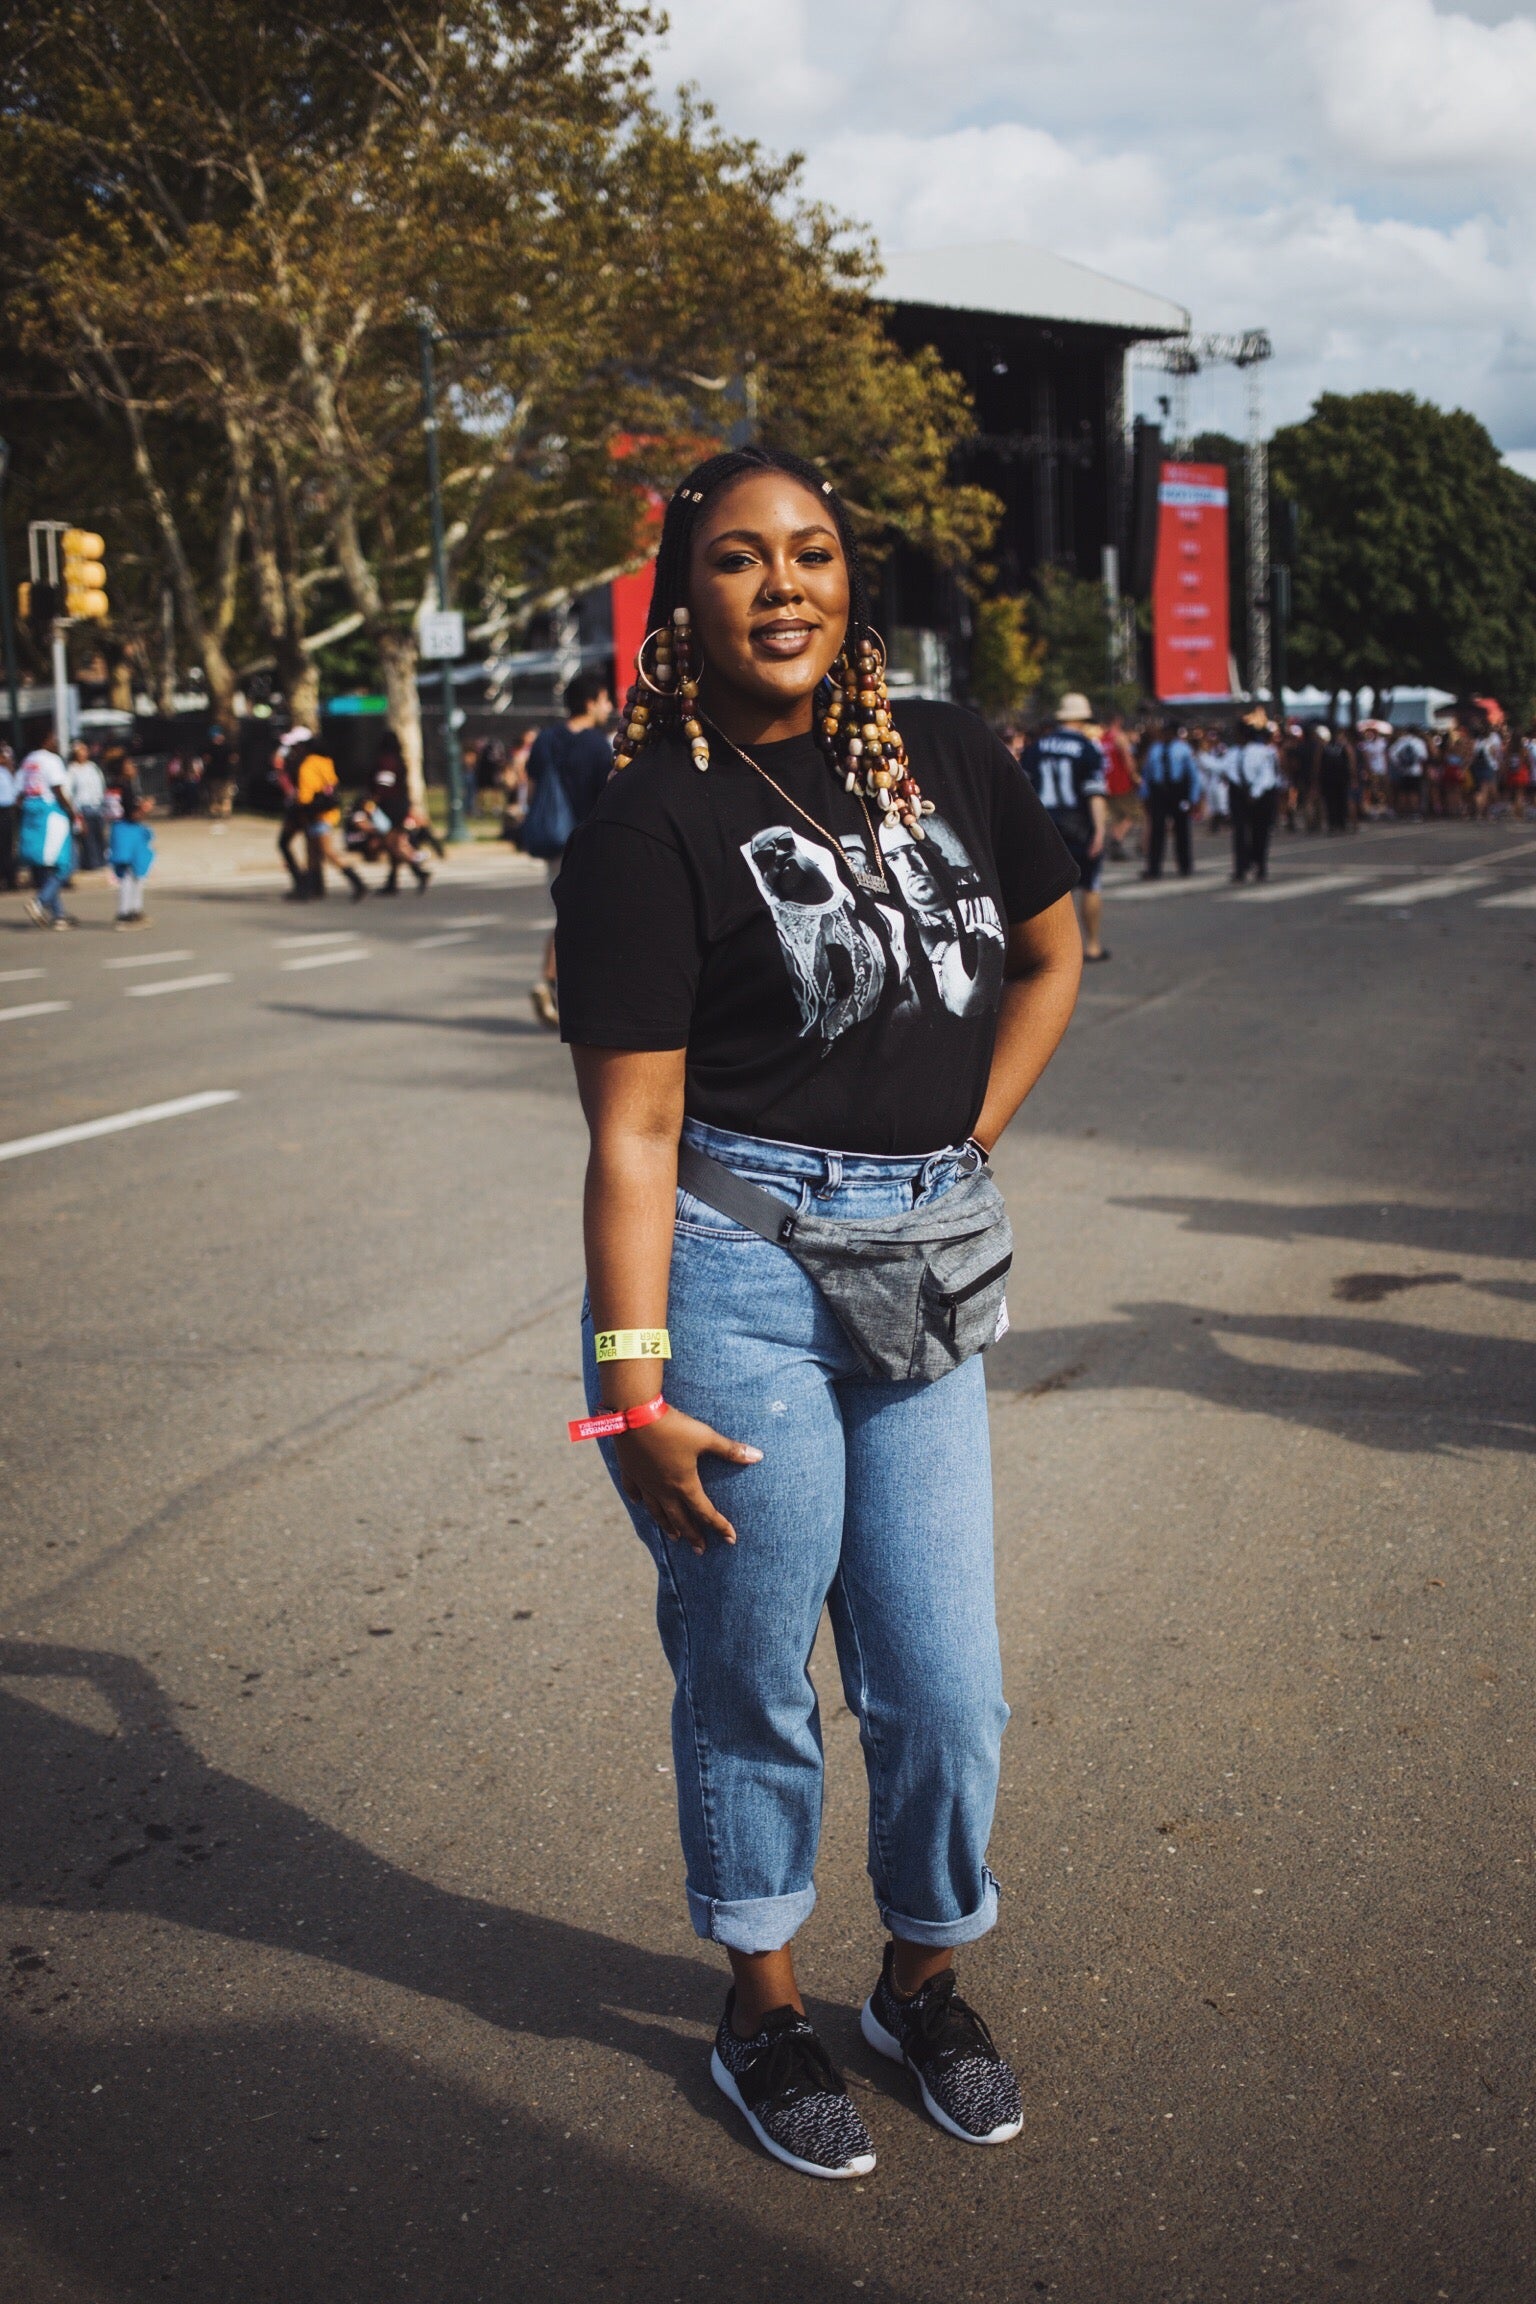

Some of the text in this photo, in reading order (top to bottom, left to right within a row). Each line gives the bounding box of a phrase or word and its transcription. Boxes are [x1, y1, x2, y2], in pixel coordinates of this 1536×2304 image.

[1039, 757, 1077, 808] 11
[599, 1334, 616, 1349] 21
[641, 1341, 660, 1354] 21
[599, 1348, 617, 1359] OVER
